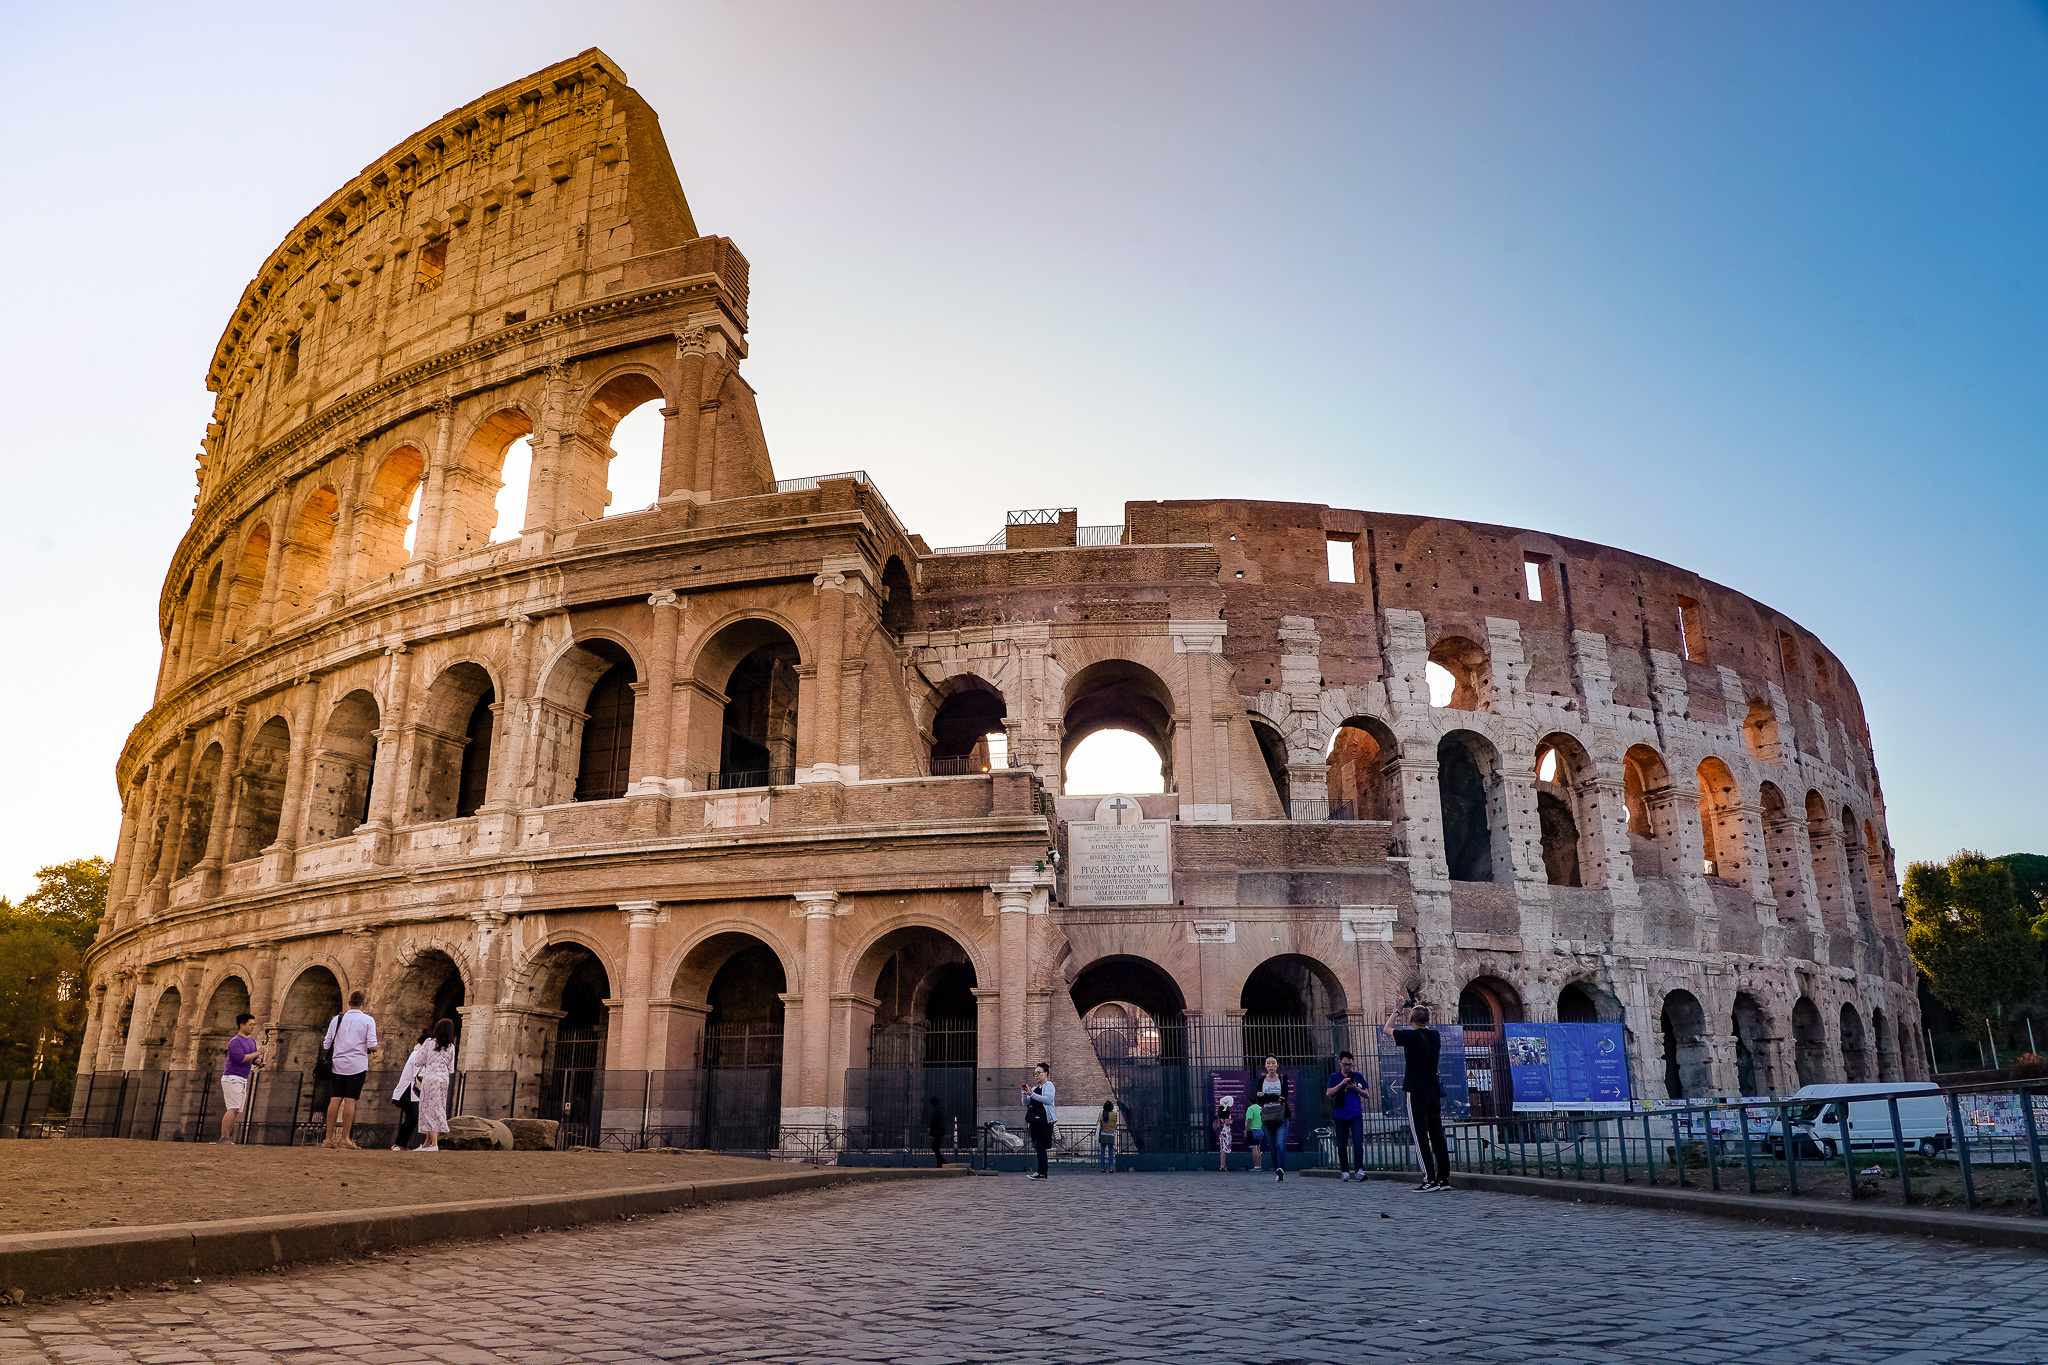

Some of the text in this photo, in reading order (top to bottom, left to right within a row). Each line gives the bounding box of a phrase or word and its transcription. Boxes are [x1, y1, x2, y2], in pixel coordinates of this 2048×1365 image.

[1081, 864, 1160, 874] PIVS IX PONT MAX
